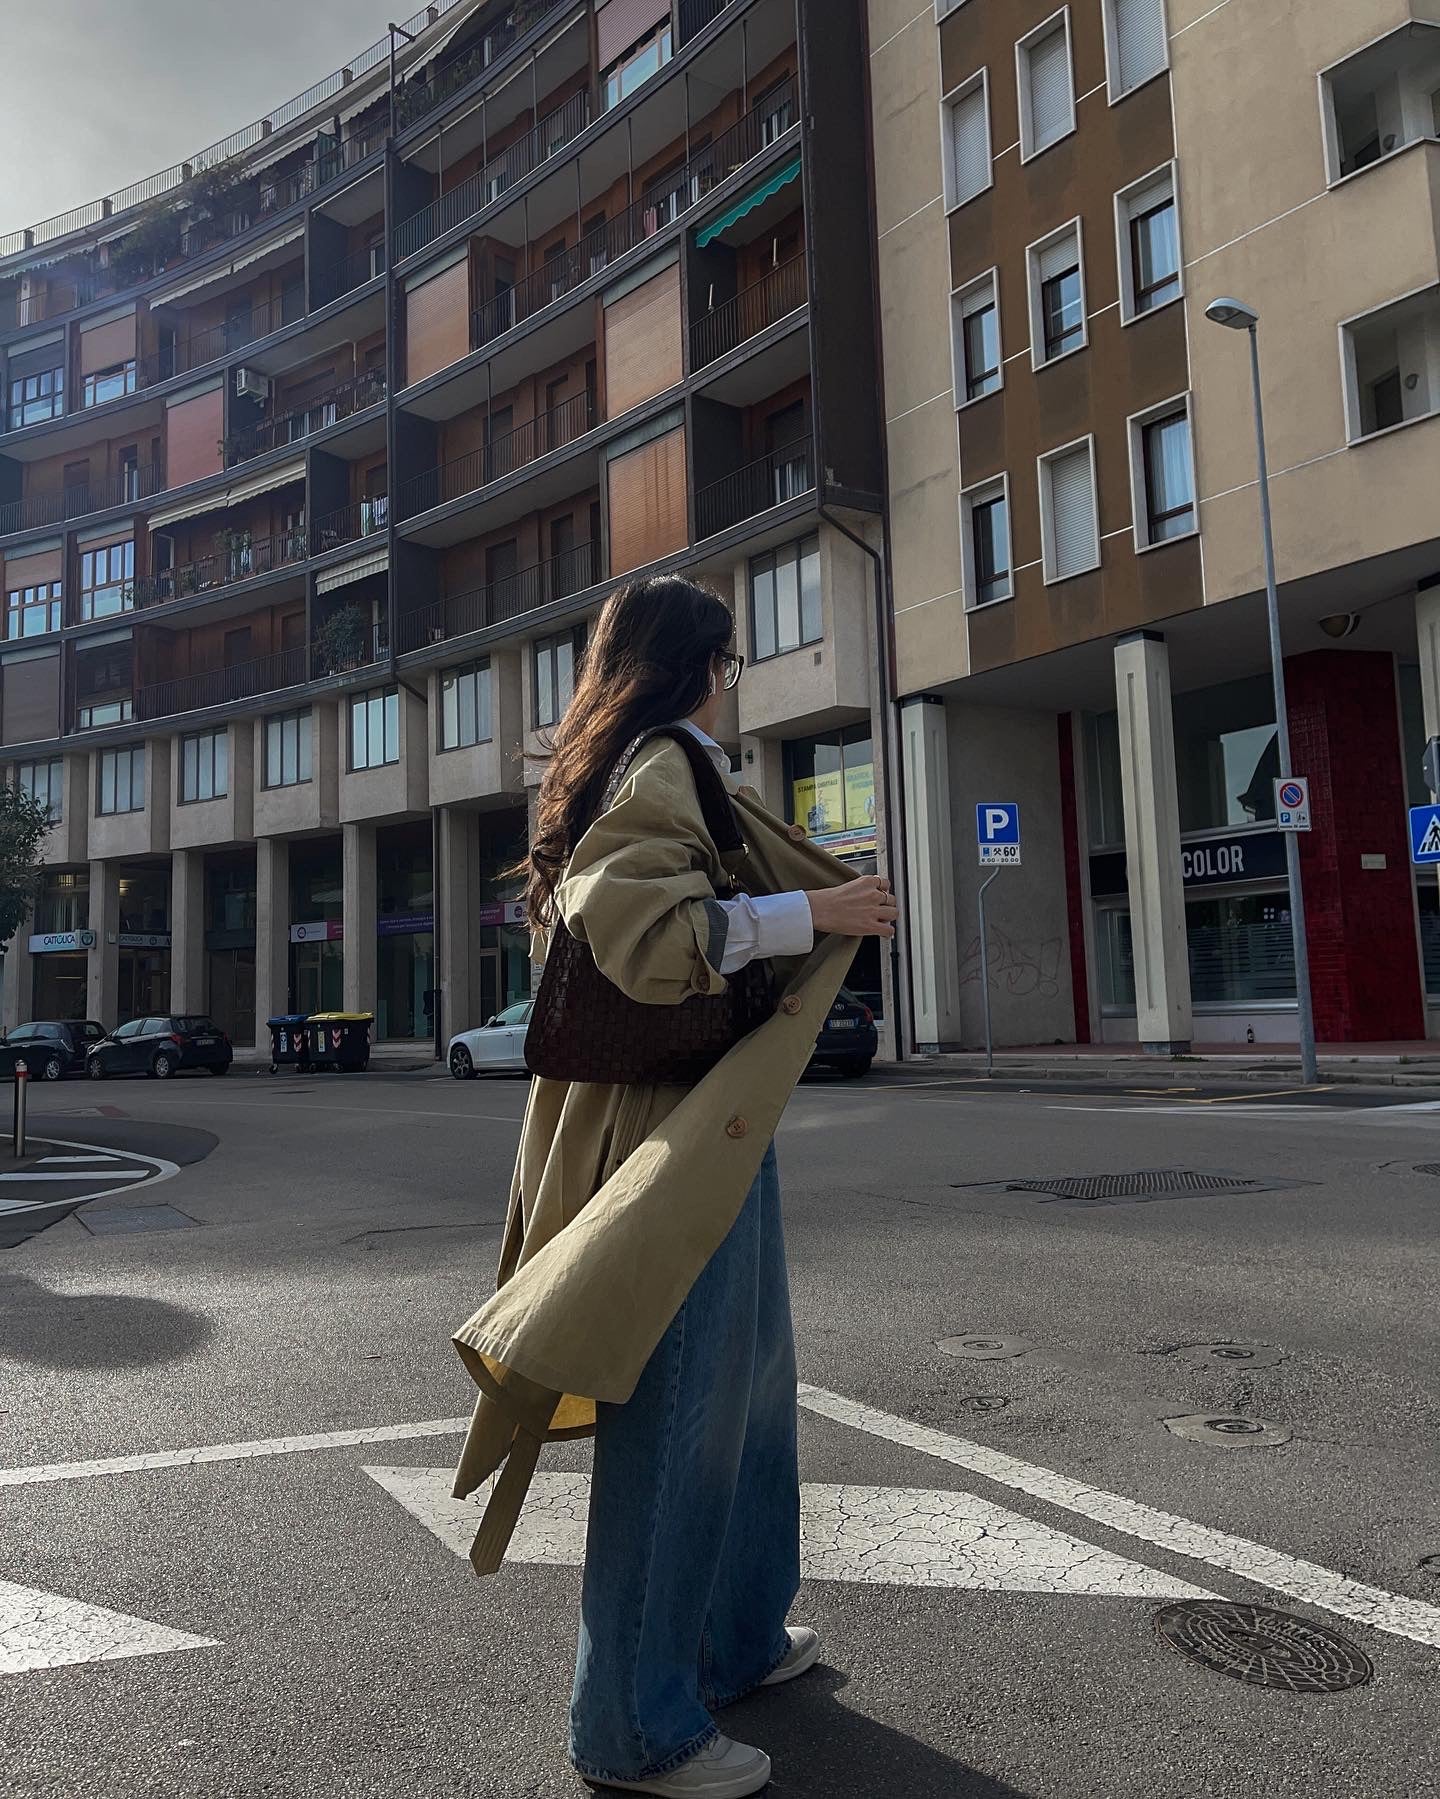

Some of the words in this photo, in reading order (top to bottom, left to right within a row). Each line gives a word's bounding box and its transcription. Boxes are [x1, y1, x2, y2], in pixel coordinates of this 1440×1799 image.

[986, 809, 1009, 839] P
[1282, 813, 1289, 822] P
[1181, 845, 1245, 878] COLOR
[44, 934, 76, 945] CATTOLICA
